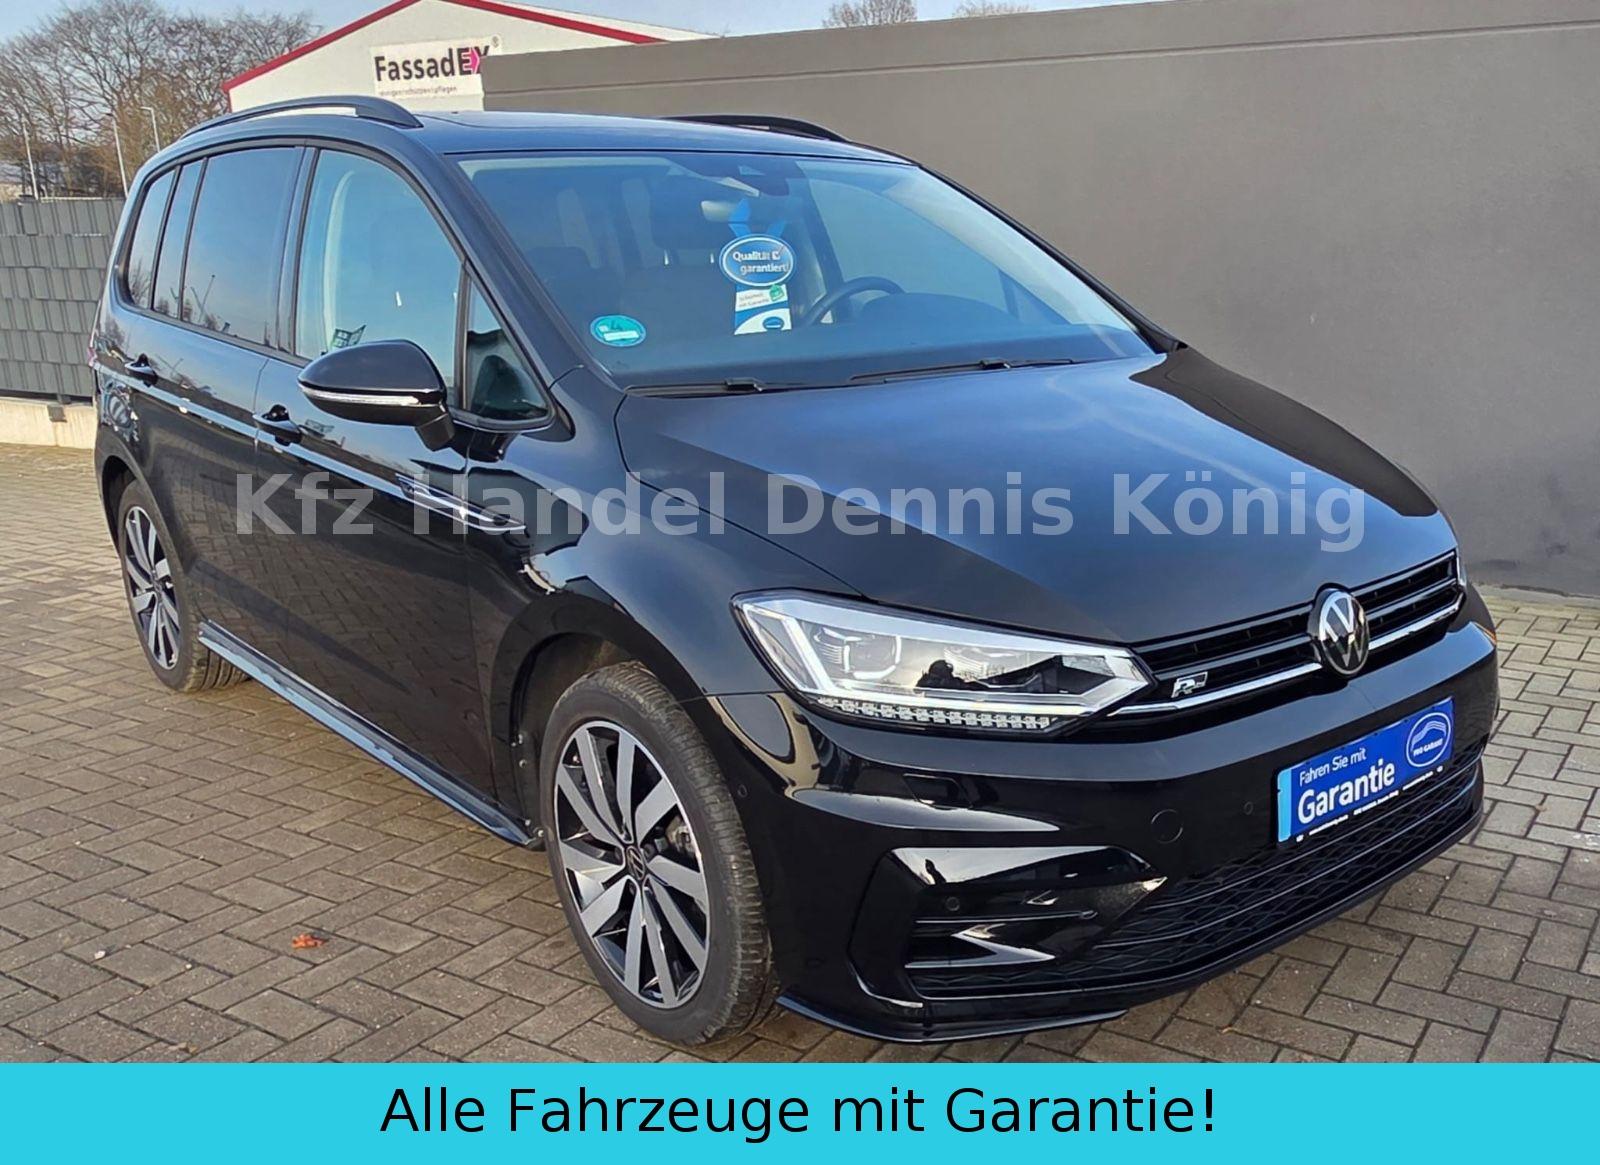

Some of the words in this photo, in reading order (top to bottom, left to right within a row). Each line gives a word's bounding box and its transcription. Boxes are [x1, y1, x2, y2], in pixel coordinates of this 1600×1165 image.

[1298, 758, 1395, 824] Garantie
[1300, 765, 1330, 787] Fahren
[1332, 755, 1349, 772] Sie
[1350, 746, 1367, 764] mit
